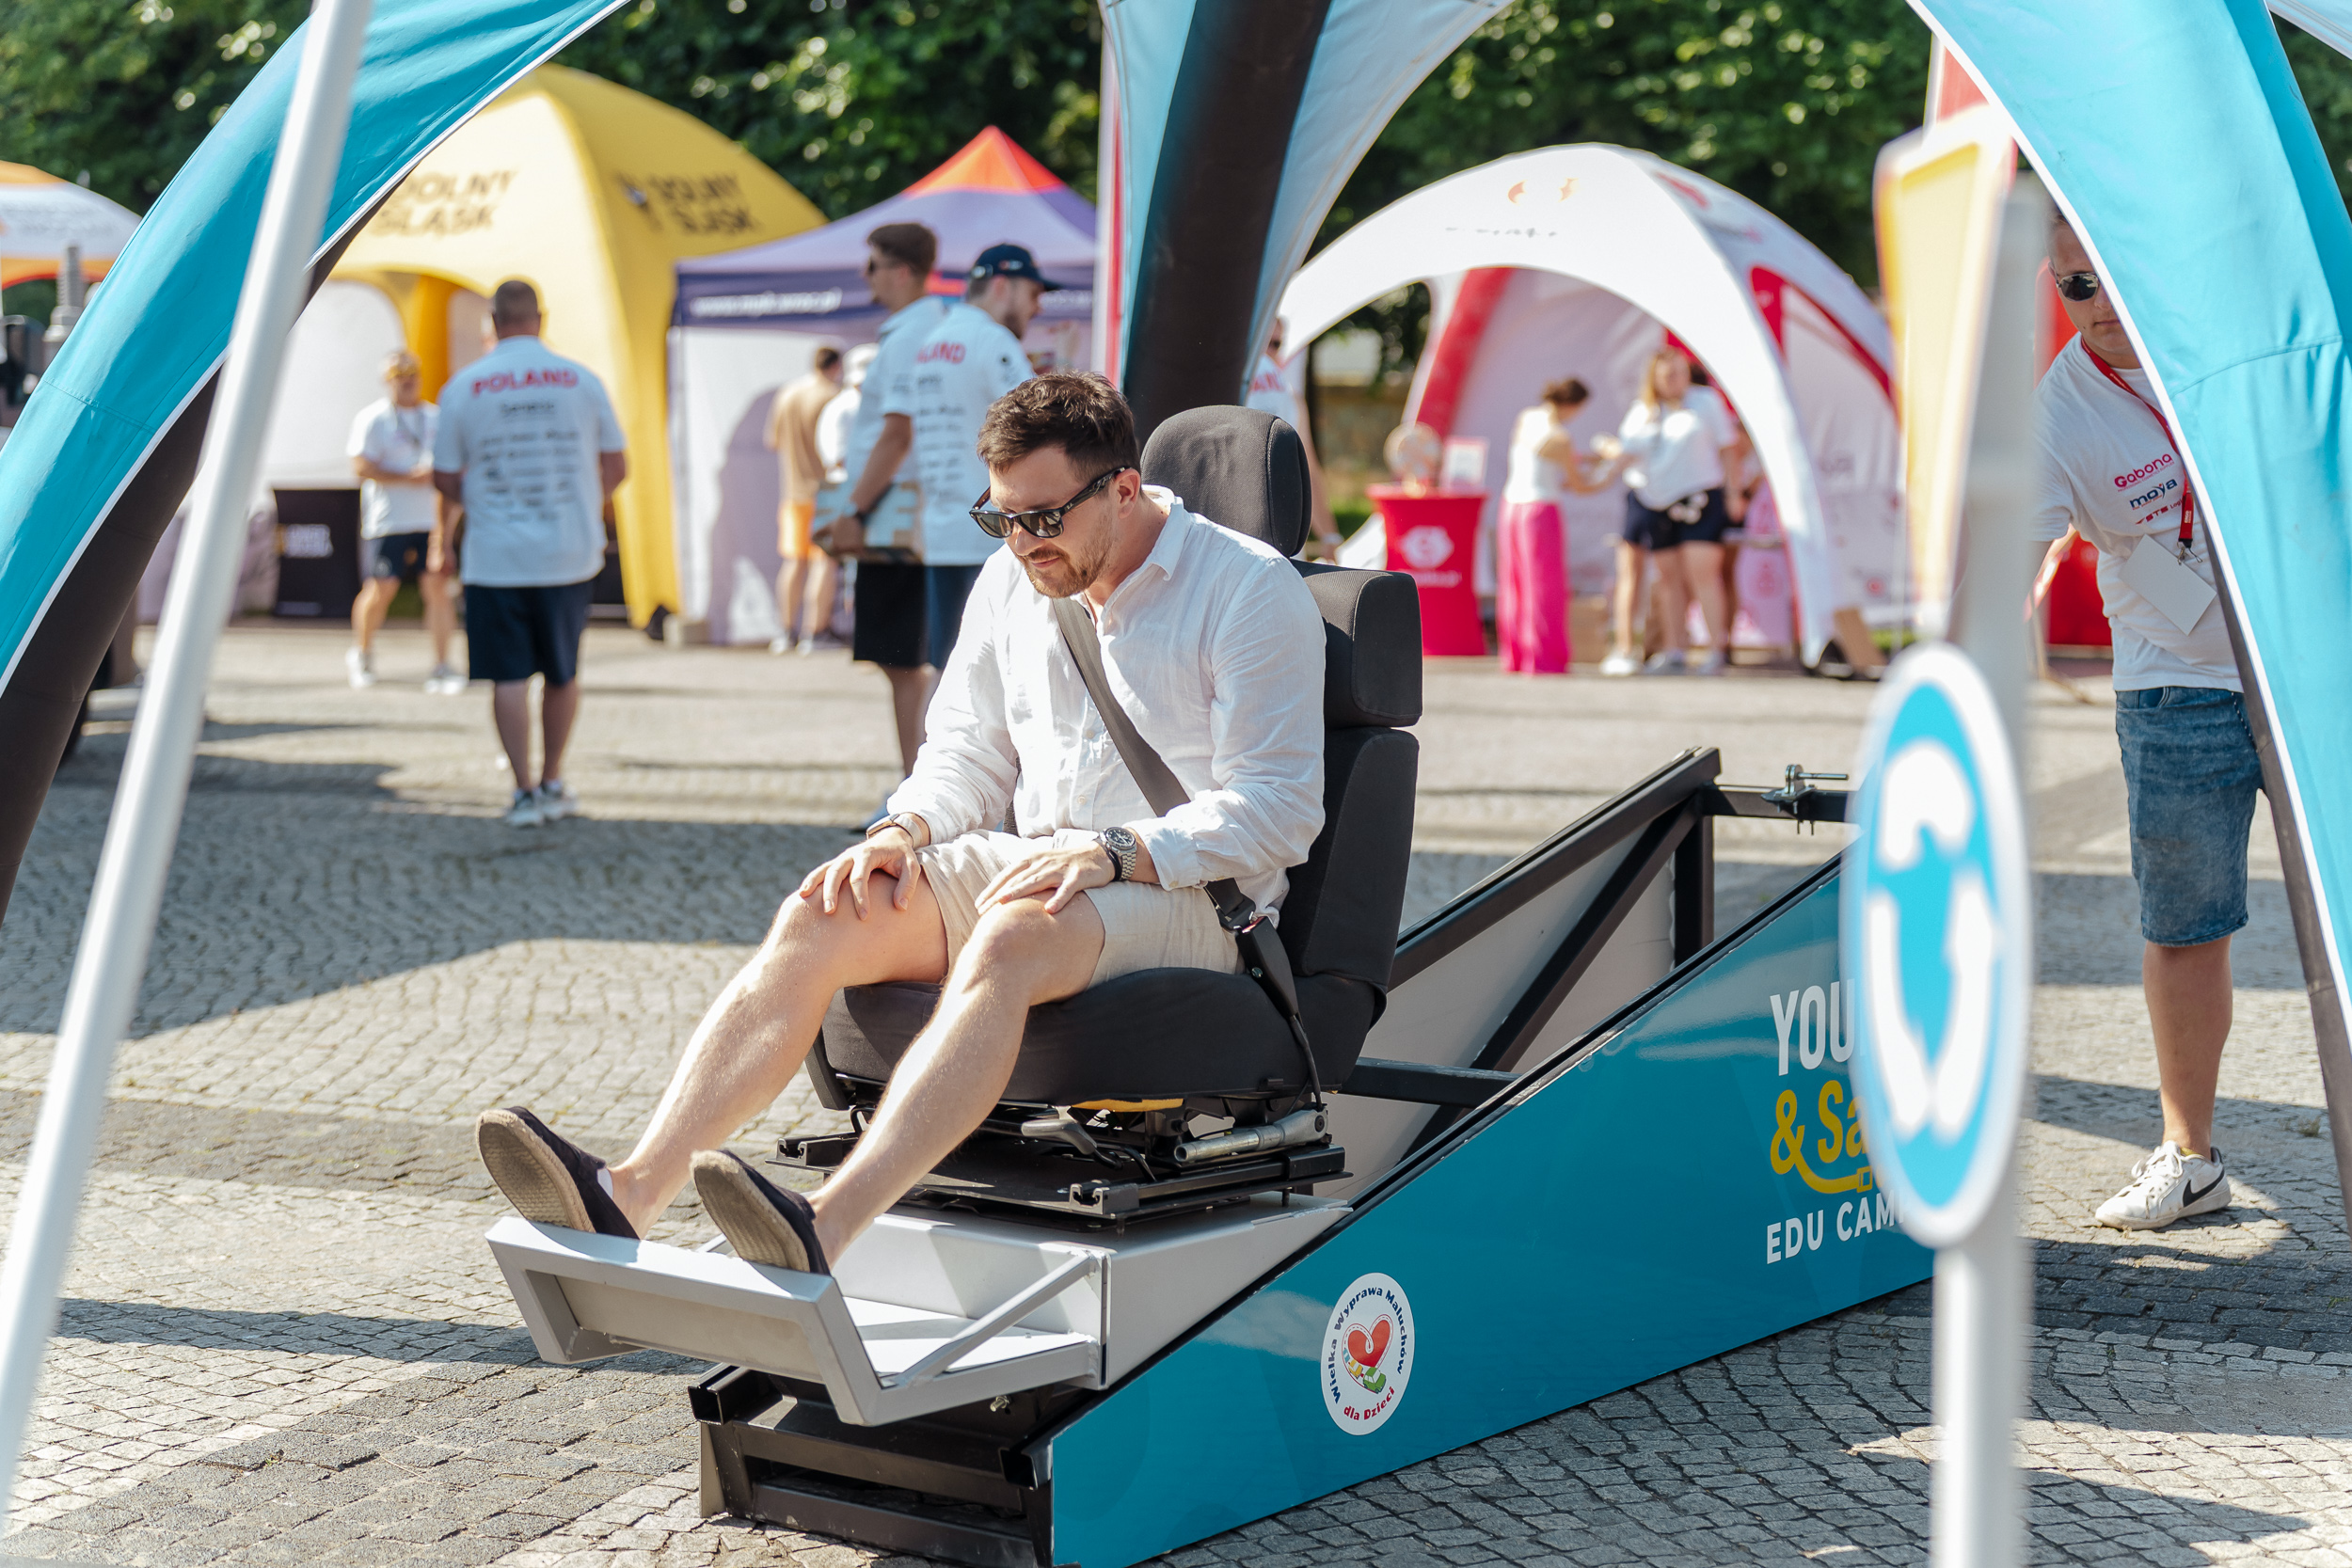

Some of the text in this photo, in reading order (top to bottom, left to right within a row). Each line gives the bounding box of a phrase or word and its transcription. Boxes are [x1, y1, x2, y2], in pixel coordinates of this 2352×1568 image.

[916, 341, 966, 364] LAND
[472, 369, 579, 398] POLAND
[2114, 453, 2173, 488] Gabona
[2129, 478, 2178, 508] moya
[1770, 978, 1862, 1076] YOU
[1818, 1080, 1870, 1164] Sa
[1767, 1210, 1823, 1264] EDU
[1327, 1287, 1408, 1404] Wielka Wyprawa Maluchów
[1343, 1386, 1395, 1421] dla Dzieci
